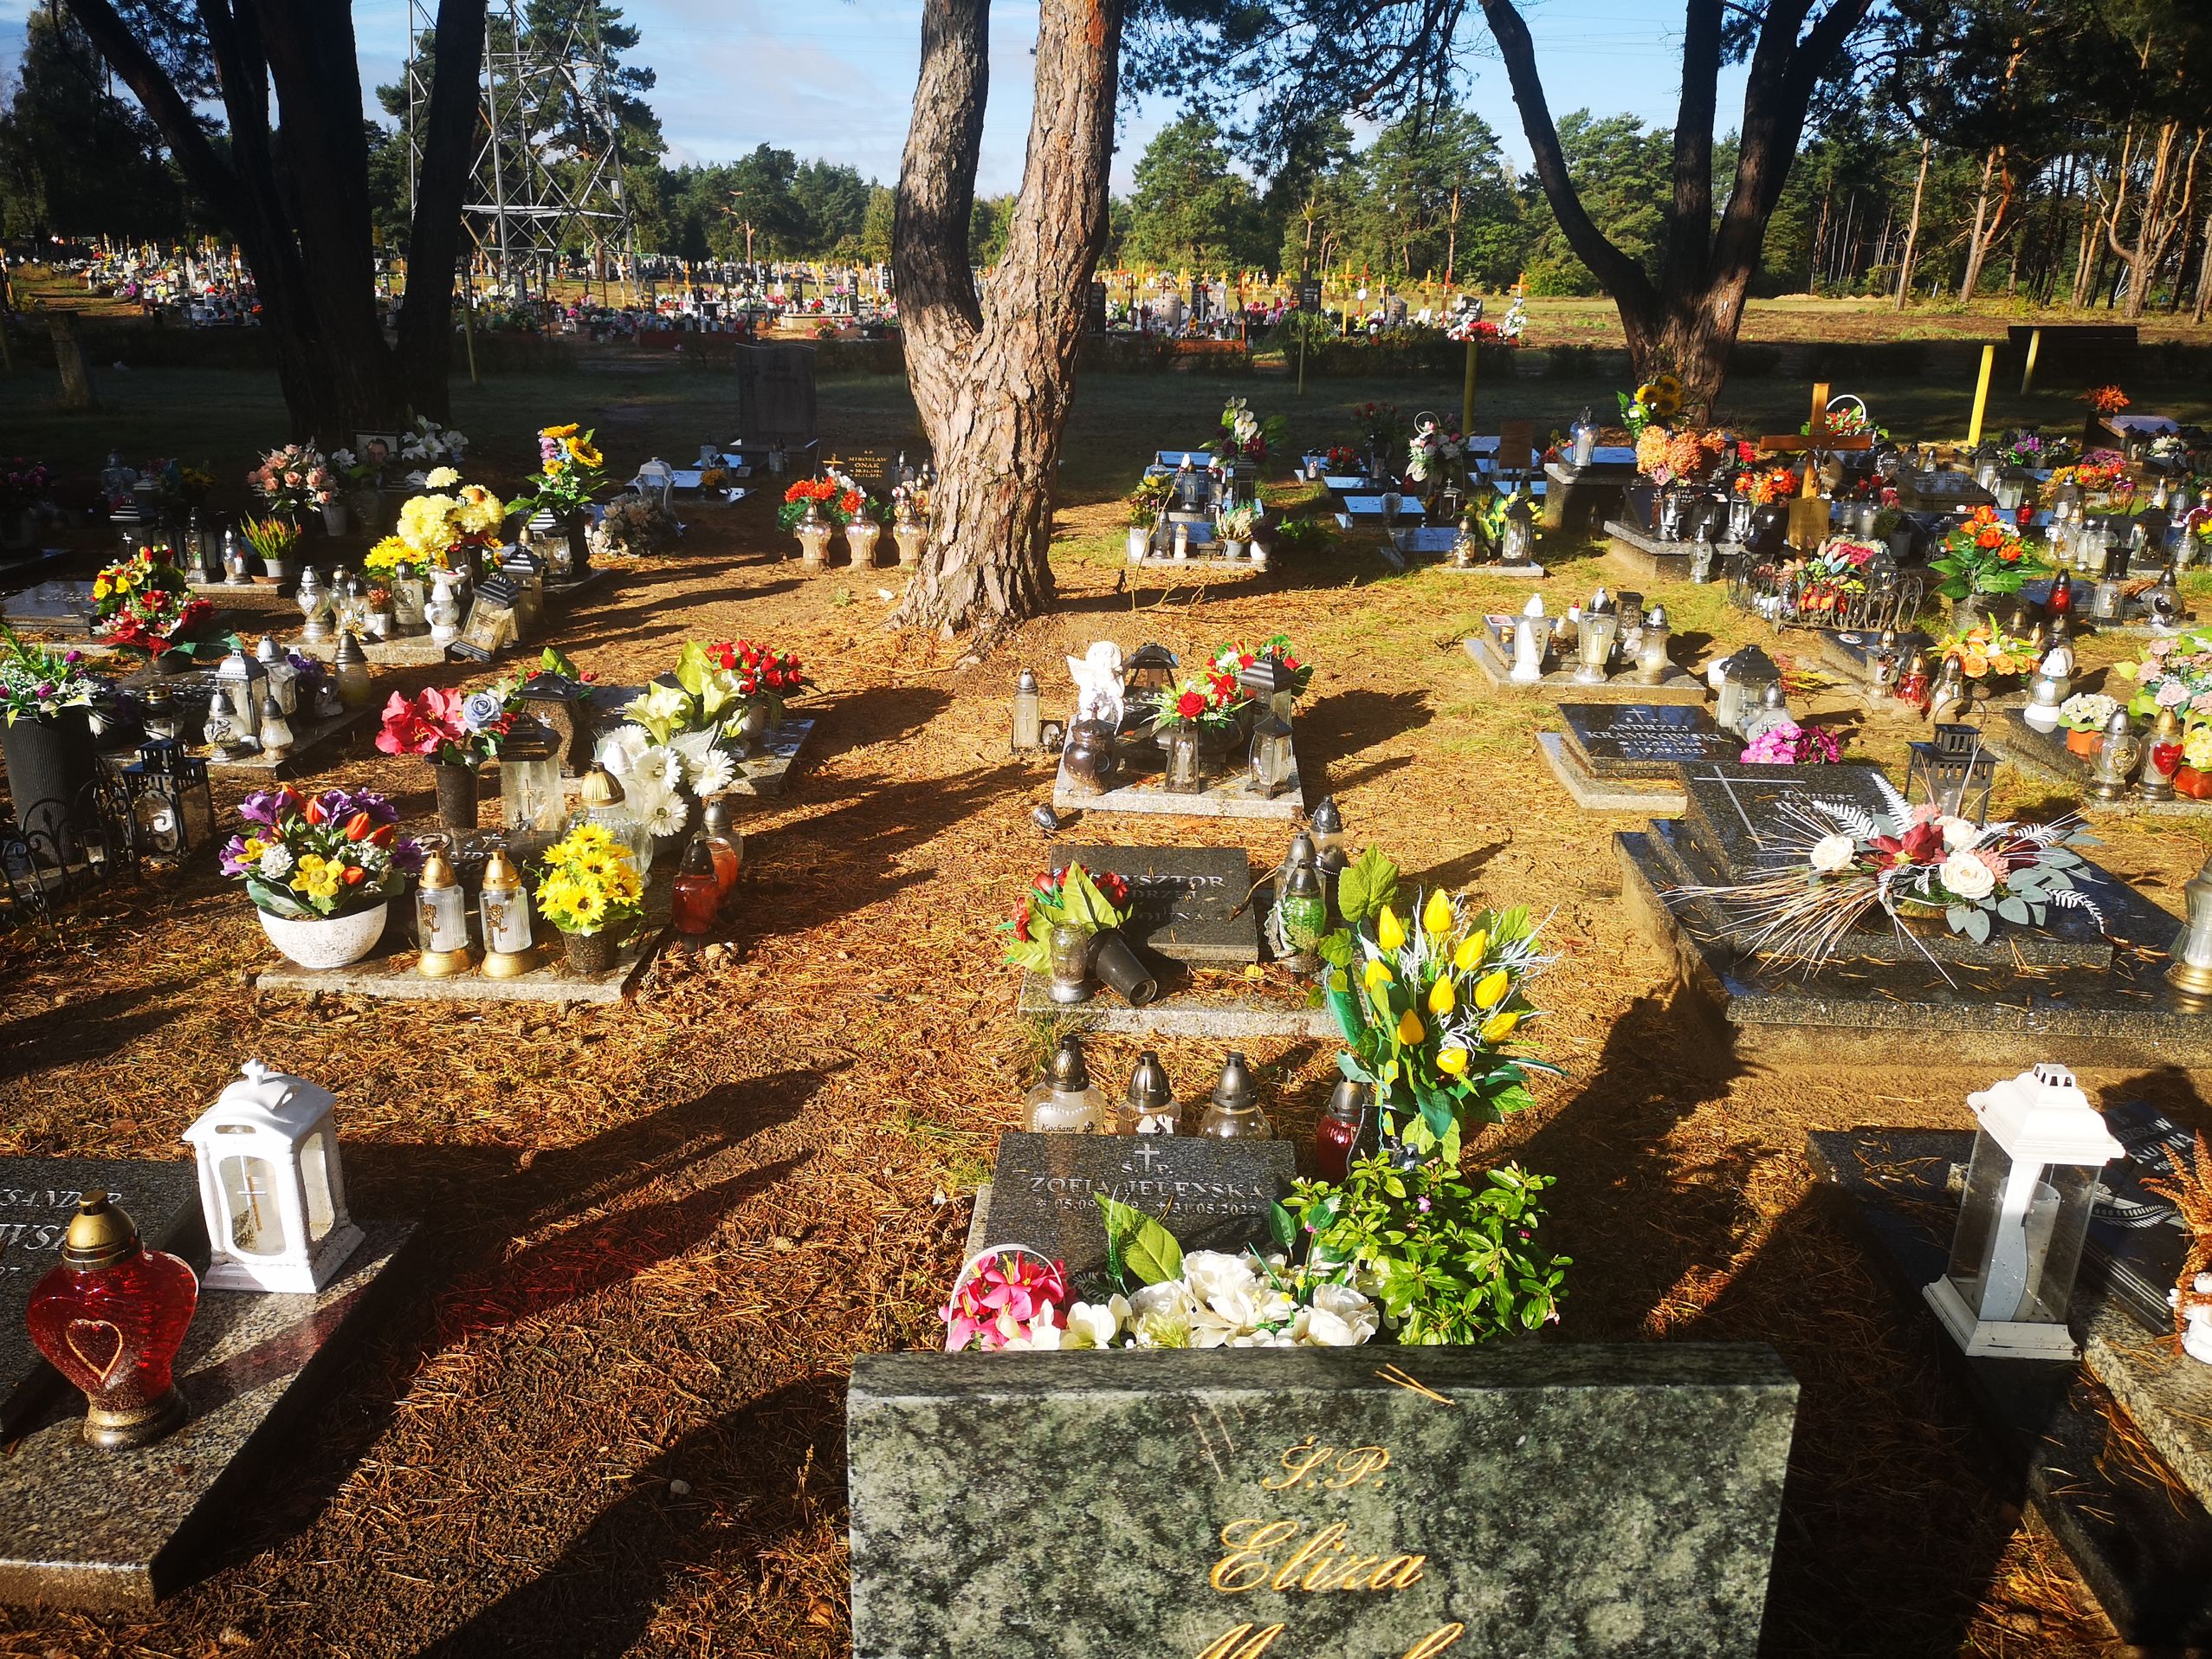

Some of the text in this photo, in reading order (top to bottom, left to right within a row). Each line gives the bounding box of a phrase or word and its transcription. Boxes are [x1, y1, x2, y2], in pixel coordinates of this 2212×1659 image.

[1585, 731, 1721, 742] KRAMKOWSKI
[1041, 1123, 1077, 1133] Kochanej
[1030, 1177, 1110, 1194] ZOFIA
[1210, 1519, 1427, 1592] Eliza
